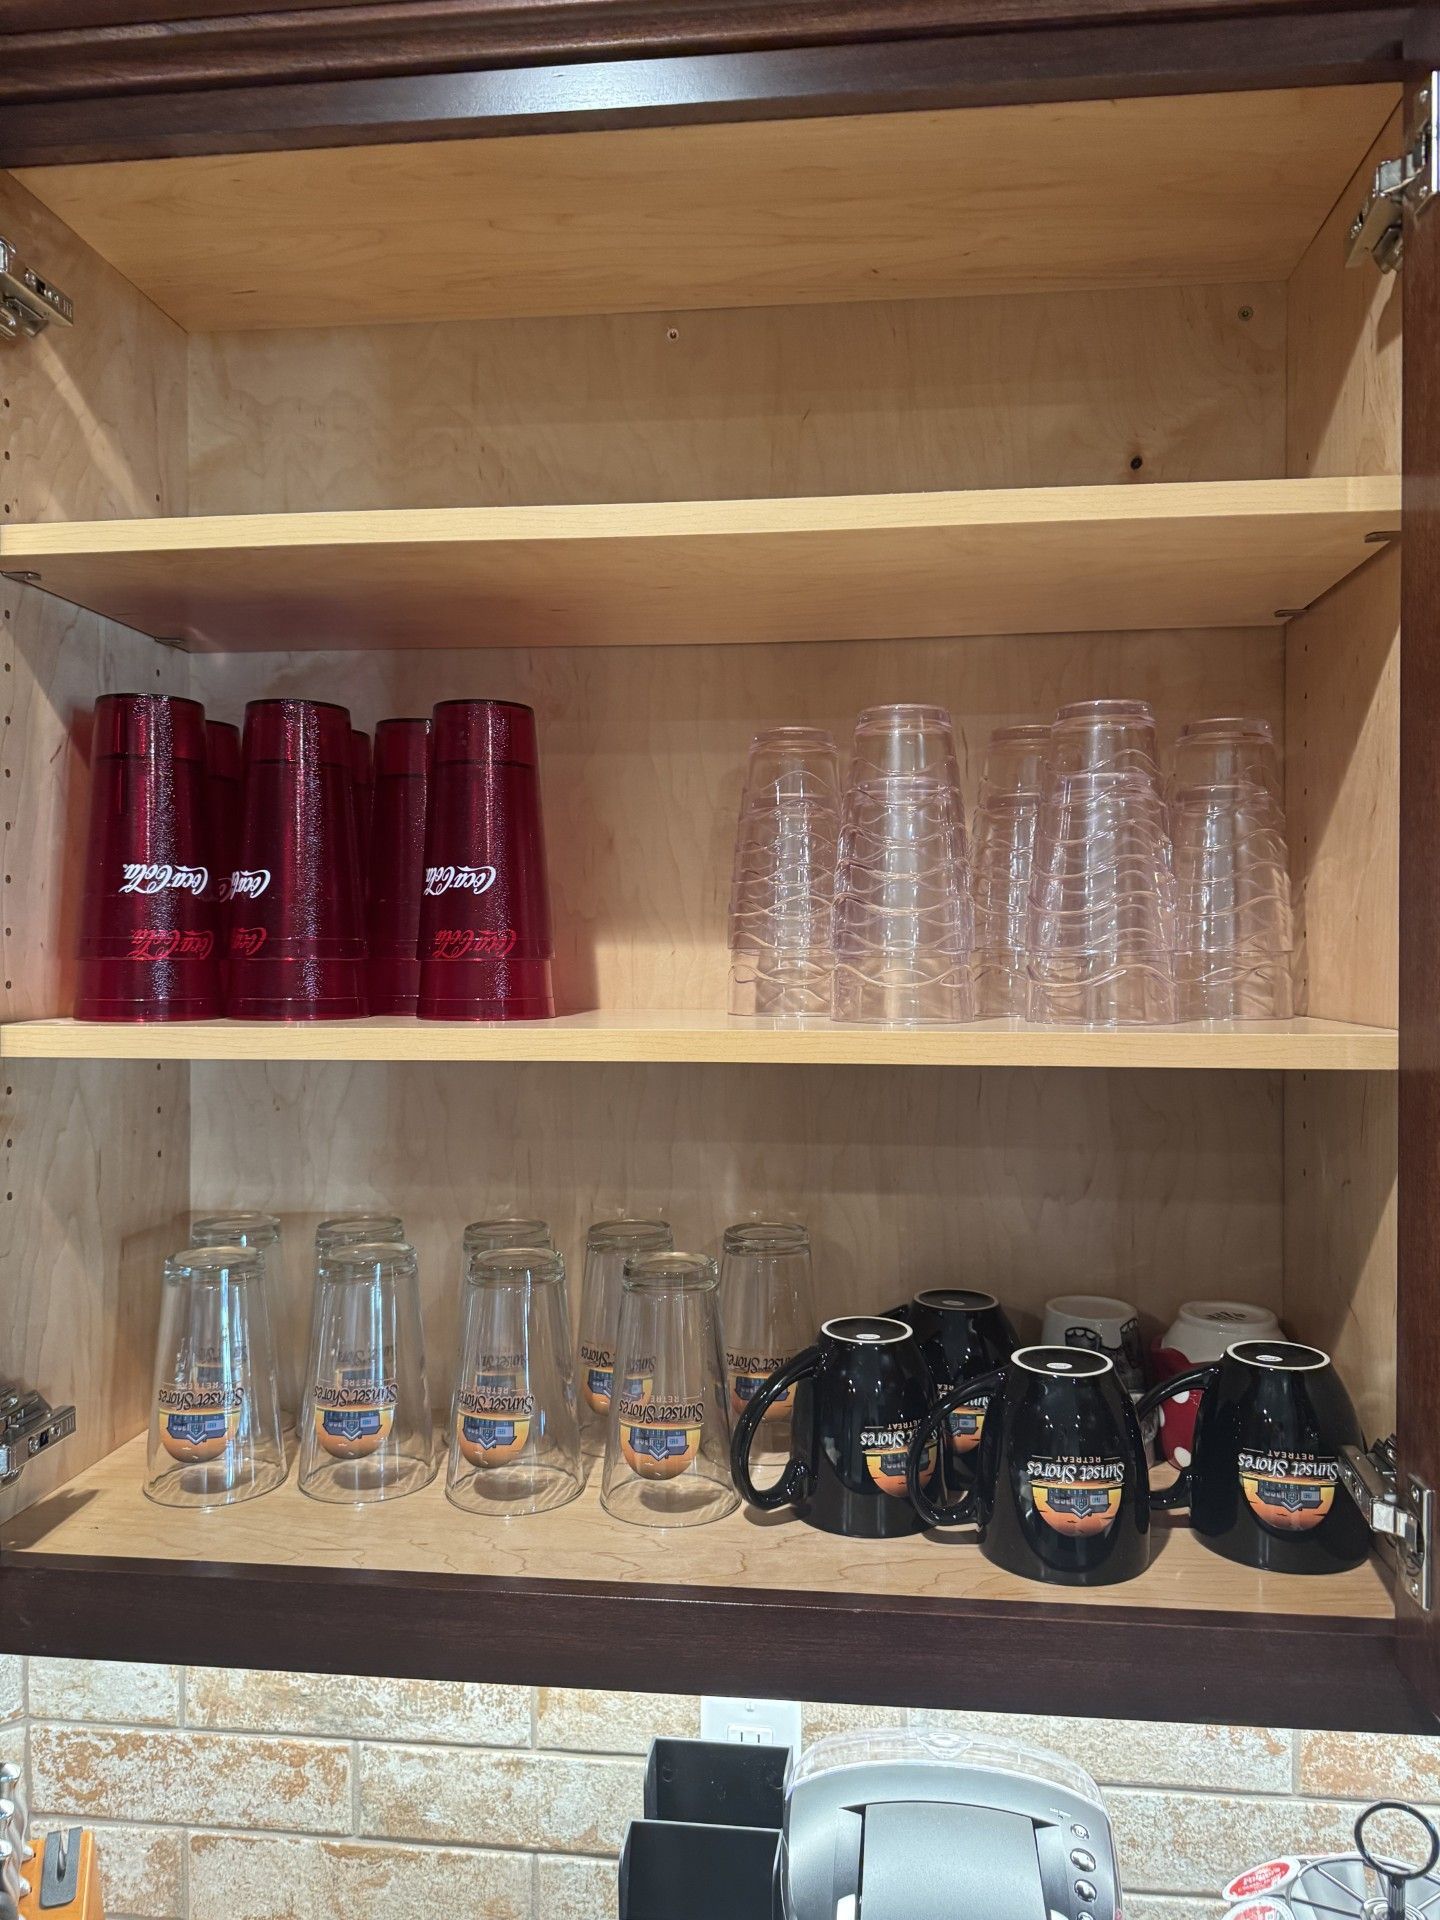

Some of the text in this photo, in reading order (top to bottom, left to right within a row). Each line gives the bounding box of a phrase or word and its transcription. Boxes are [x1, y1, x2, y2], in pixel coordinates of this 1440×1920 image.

[313, 1385, 349, 1408] Shores
[489, 1396, 534, 1415] Sunset
[619, 1400, 704, 1424] Sunset Shores
[860, 1431, 906, 1450] Shores
[1055, 1455, 1101, 1464] RETREAT
[1267, 1449, 1315, 1461] RETREAT
[1026, 1461, 1125, 1484] Sunset Shores
[1238, 1453, 1339, 1480] Sunset Shores
